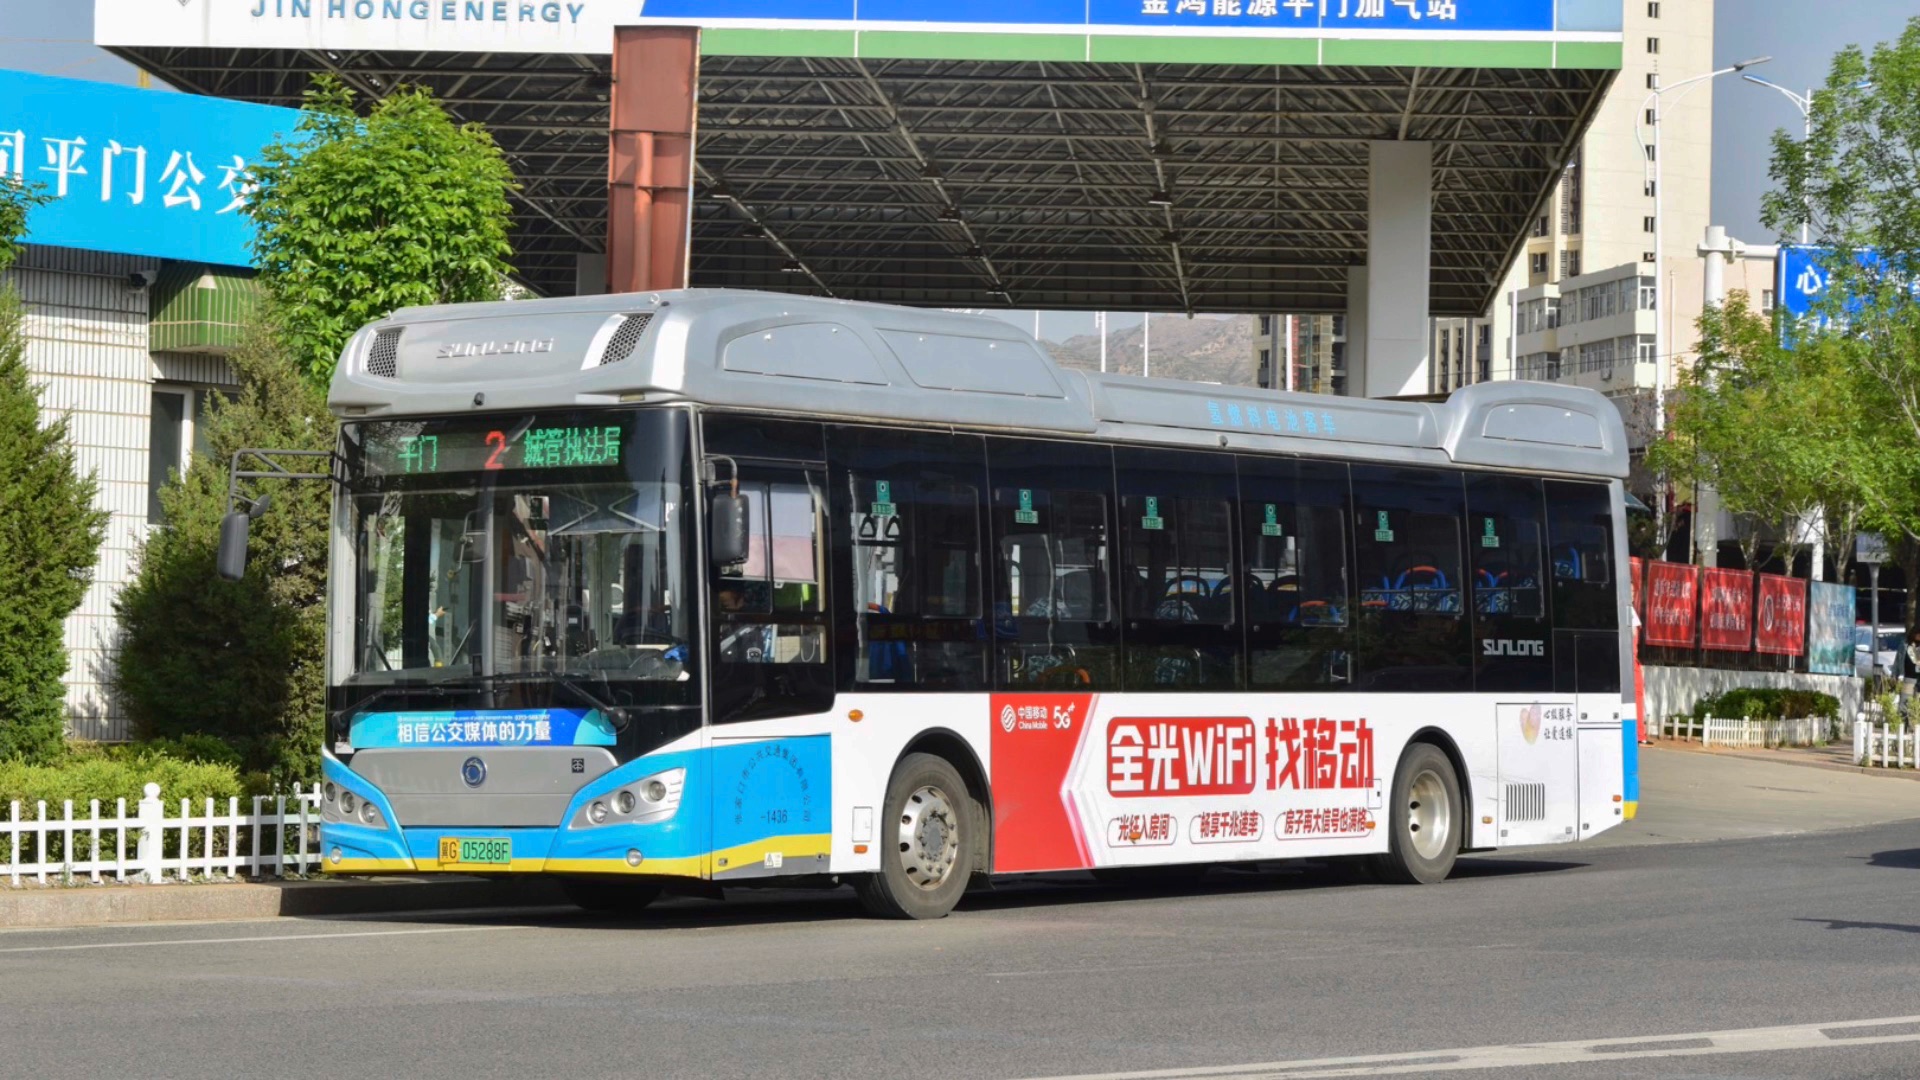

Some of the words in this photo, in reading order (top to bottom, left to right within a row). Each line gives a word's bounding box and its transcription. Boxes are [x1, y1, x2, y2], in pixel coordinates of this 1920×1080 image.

[251, 0, 311, 17] JIN
[399, 435, 437, 472] 平门
[485, 431, 506, 470] 2
[524, 427, 621, 465] 城管执法局
[1483, 639, 1544, 656] SUNLONG
[1018, 706, 1048, 719] 中国移动
[1053, 706, 1071, 729] 5G
[398, 721, 551, 743] 相信公交媒体的力量
[1018, 721, 1031, 729] China
[1032, 721, 1048, 729] Mobile
[1110, 723, 1253, 791] 全光WiFi
[1266, 718, 1374, 790] 找移动
[1200, 811, 1258, 837] 畅享千兆速率
[1284, 808, 1367, 834] 房子再大信号也满格
